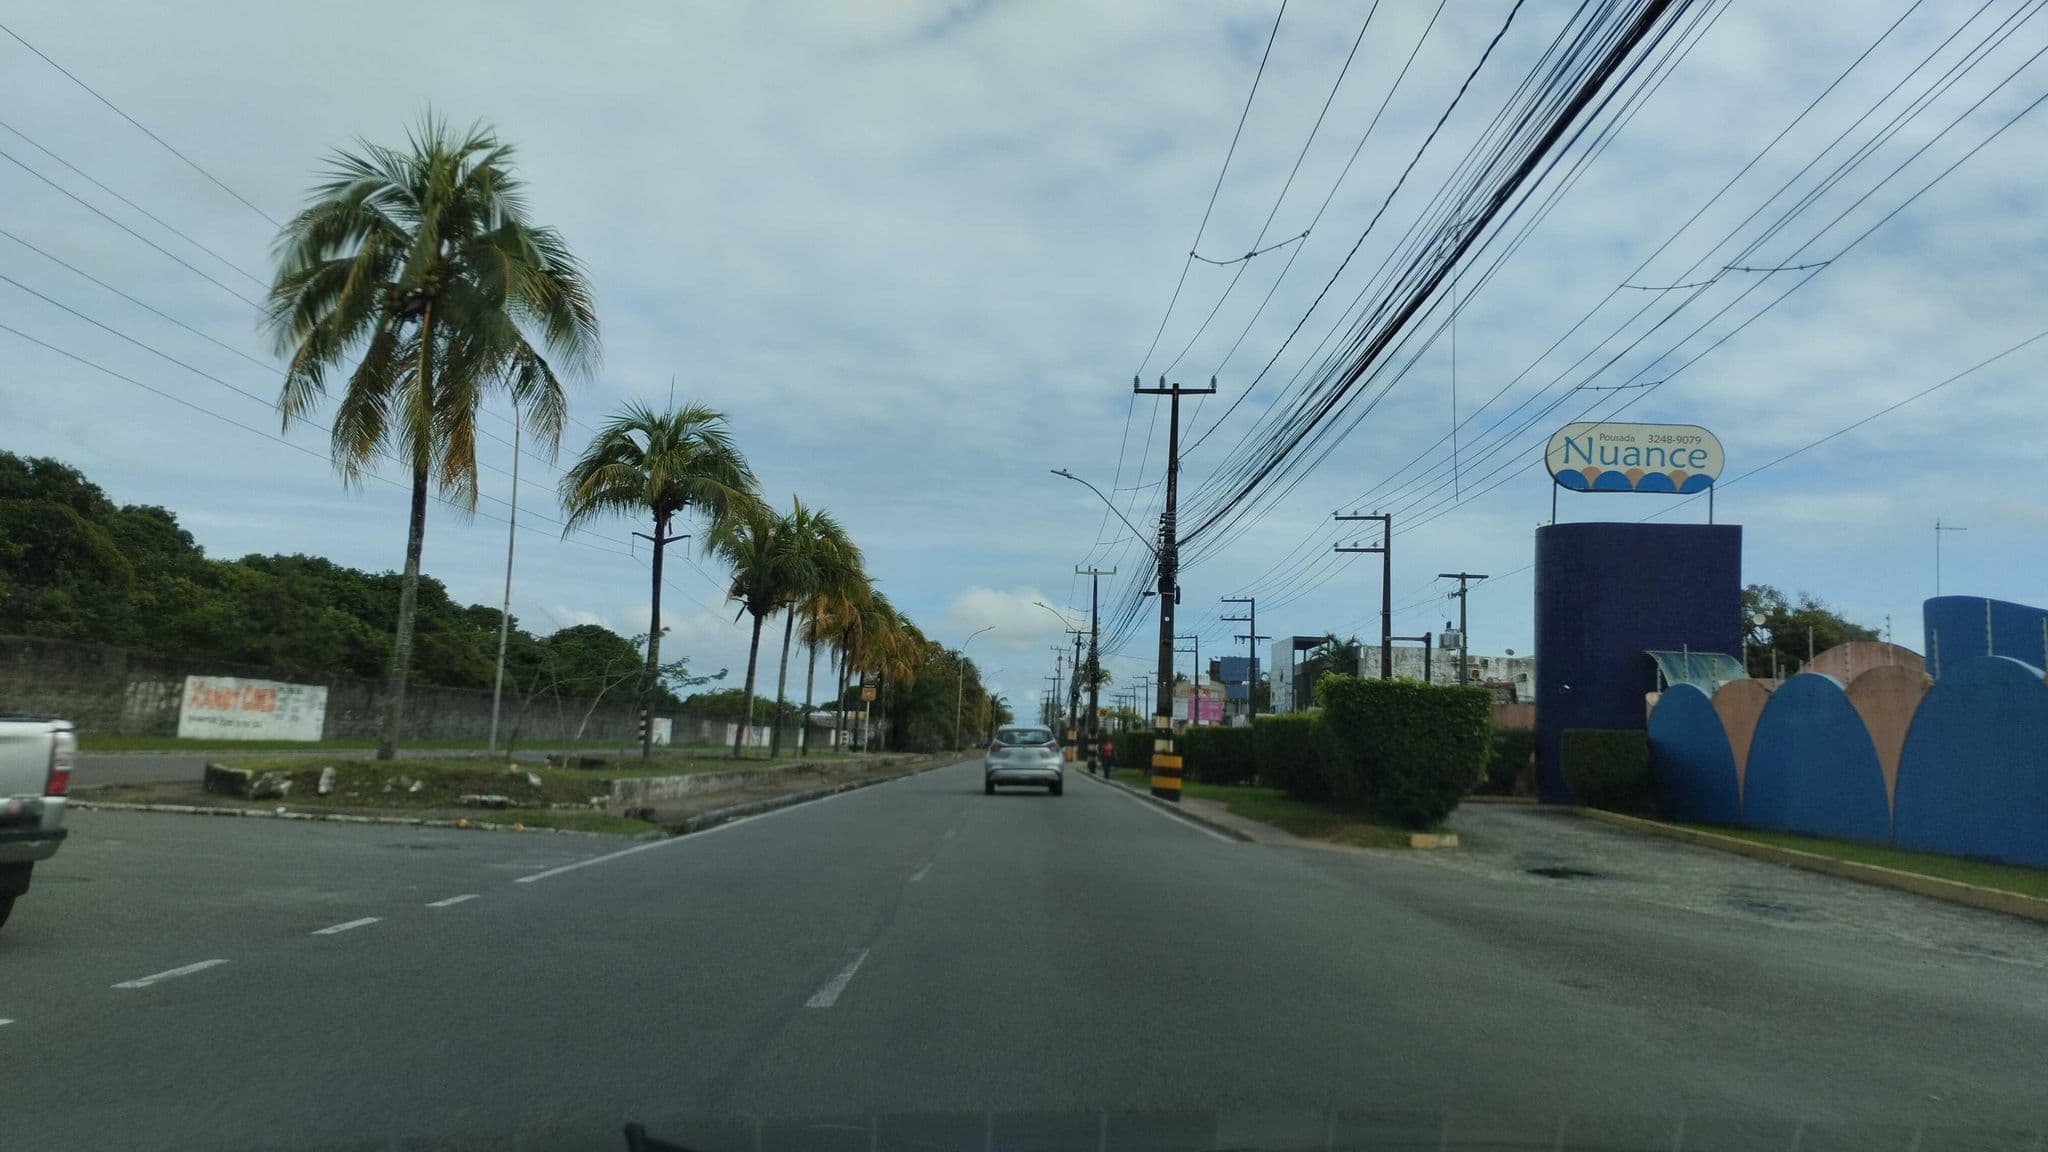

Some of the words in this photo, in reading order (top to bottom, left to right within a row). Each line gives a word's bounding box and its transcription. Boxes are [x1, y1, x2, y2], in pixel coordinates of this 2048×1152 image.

[1599, 433, 1635, 442] Pousada
[1648, 434, 1702, 445] 3248-9079
[1563, 436, 1708, 469] Nuance
